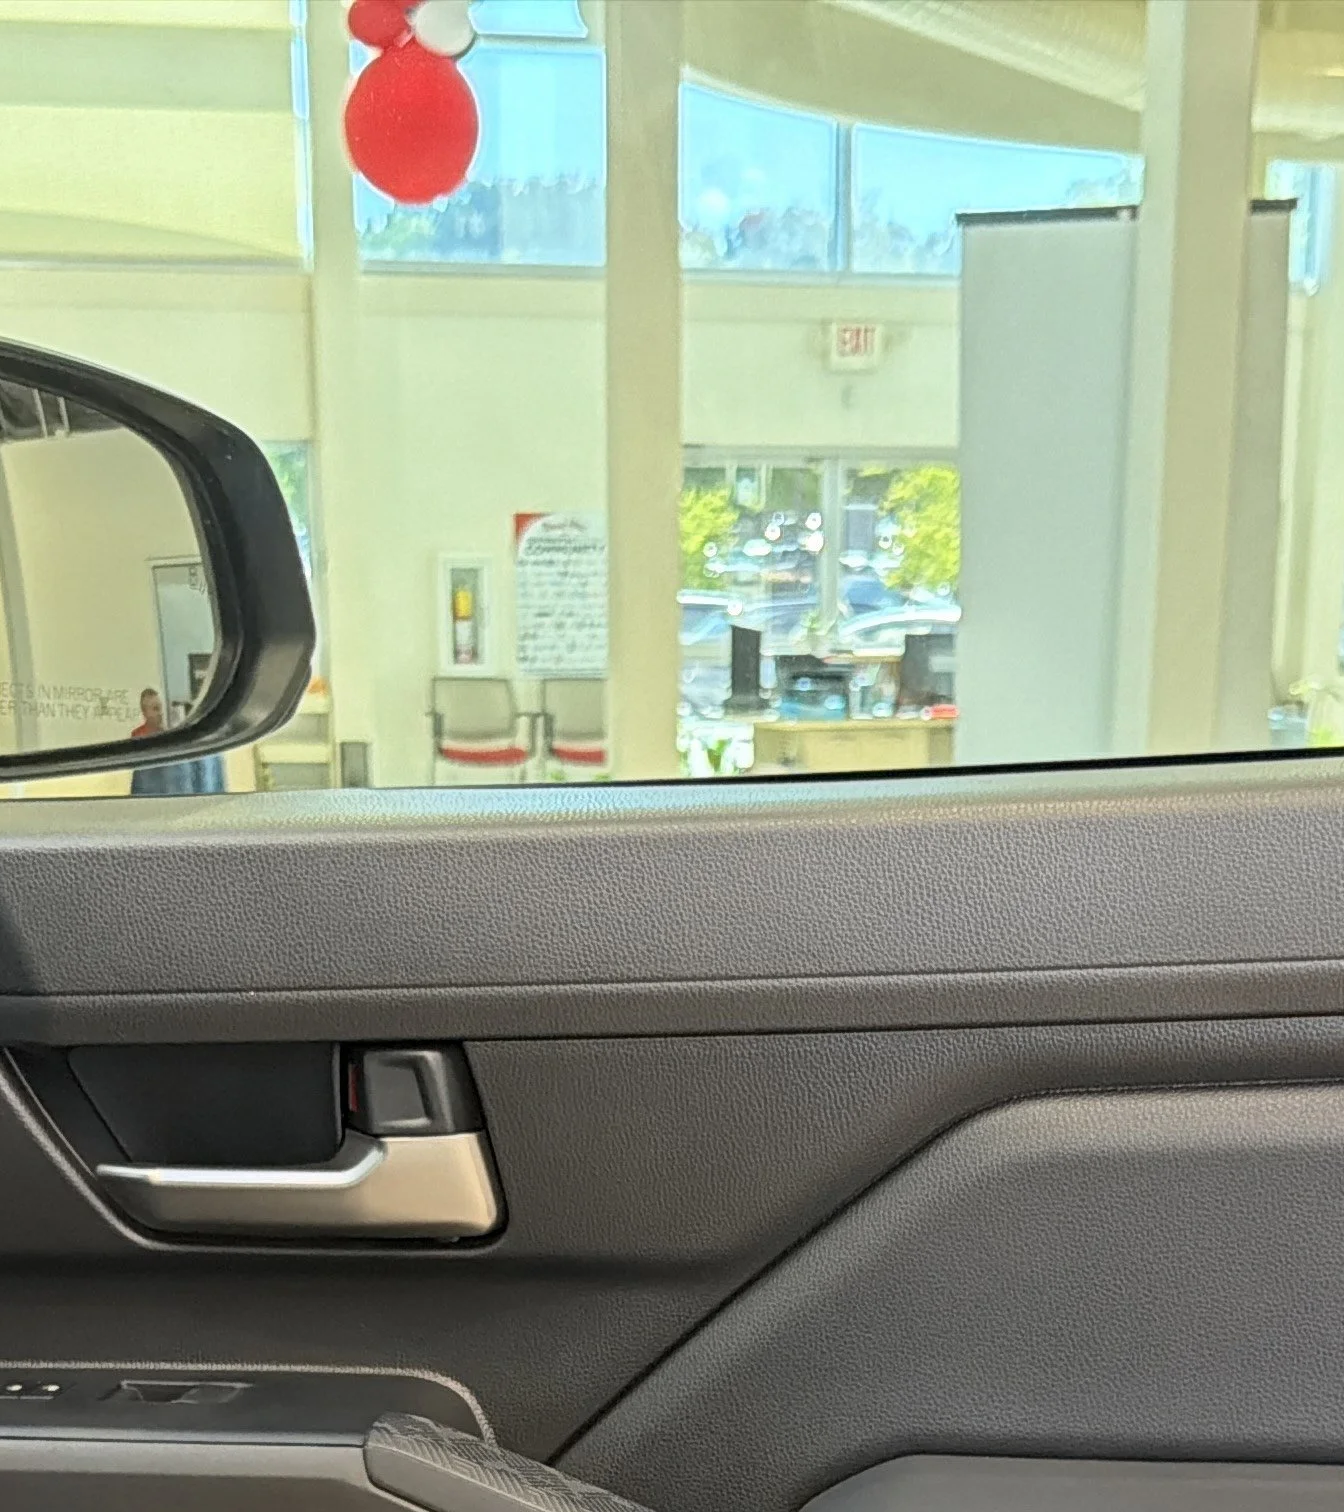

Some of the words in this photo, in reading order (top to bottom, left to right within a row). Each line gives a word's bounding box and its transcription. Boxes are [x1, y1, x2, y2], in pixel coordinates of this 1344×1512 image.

[37, 684, 51, 699] IN
[52, 684, 102, 703] MIRROR
[19, 700, 55, 718] THAN
[56, 703, 89, 720] THEY
